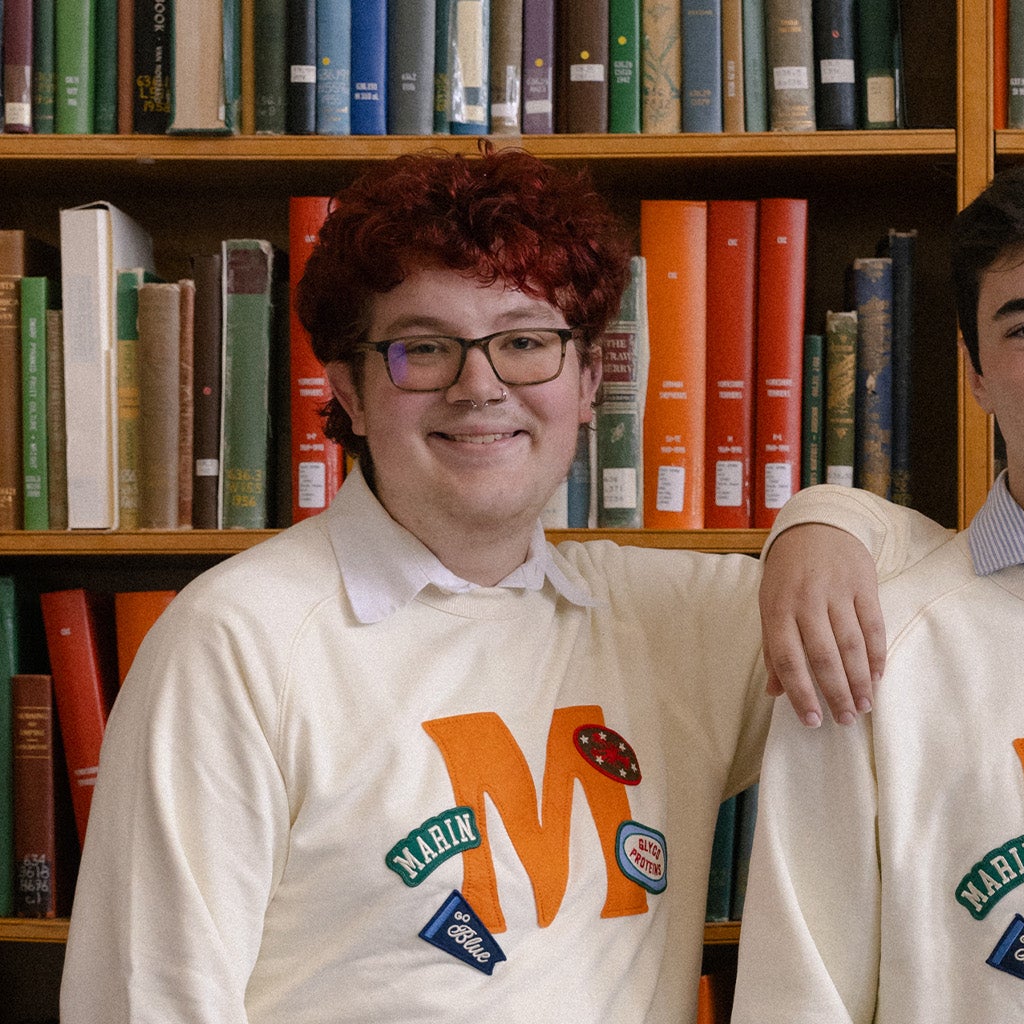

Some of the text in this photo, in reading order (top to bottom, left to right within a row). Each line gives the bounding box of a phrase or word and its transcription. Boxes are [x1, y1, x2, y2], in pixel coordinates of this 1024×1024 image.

[421, 705, 649, 934] M
[392, 812, 477, 880] MARIN
[628, 848, 662, 877] PROTEINS
[638, 837, 661, 859] GLYCO
[454, 910, 471, 923] GO
[447, 922, 492, 964] Blue
